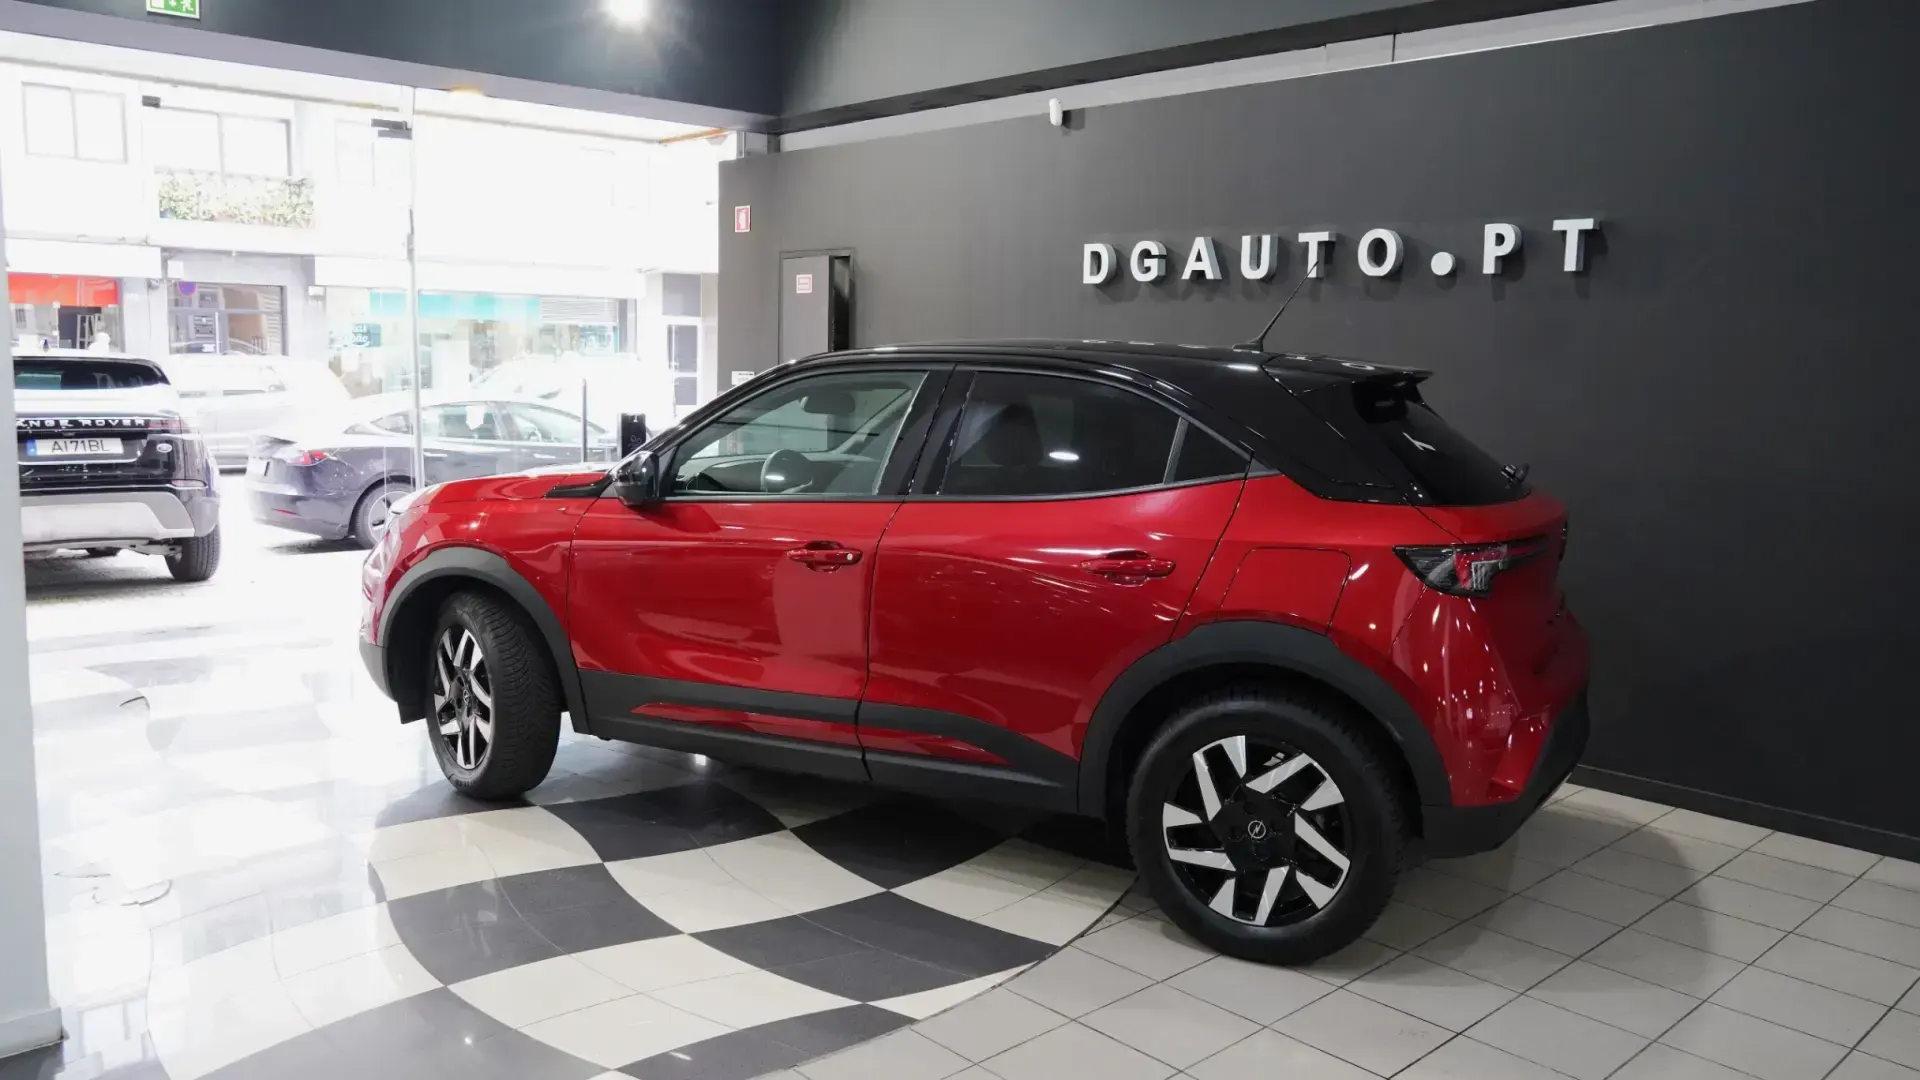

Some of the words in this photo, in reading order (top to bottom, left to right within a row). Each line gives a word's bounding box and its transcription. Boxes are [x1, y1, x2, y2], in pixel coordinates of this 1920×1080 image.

[1082, 218, 1600, 285] DGAUTO.PT
[16, 419, 73, 427] ANGE
[51, 439, 111, 453] AI71BL
